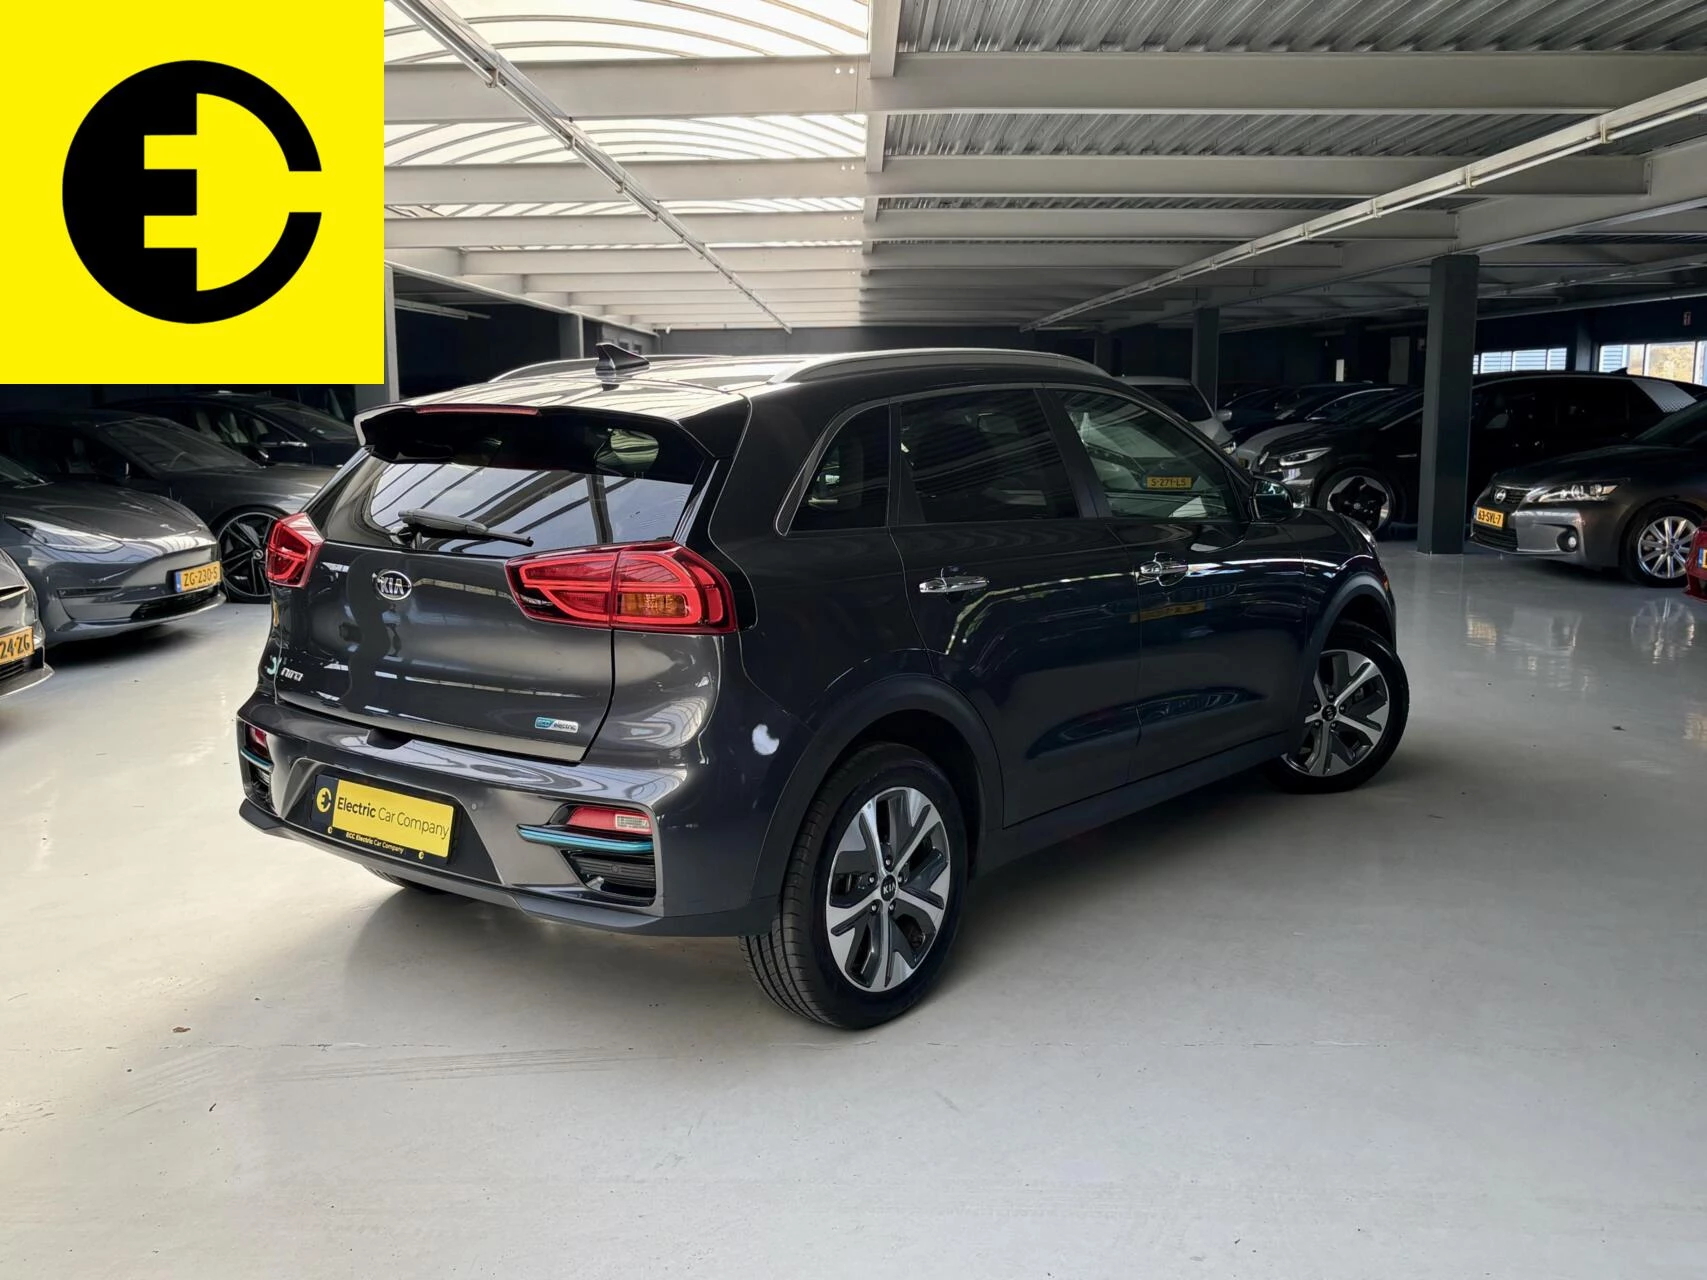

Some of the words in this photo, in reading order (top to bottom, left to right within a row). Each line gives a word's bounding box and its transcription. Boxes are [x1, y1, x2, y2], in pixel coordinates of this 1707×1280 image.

[380, 576, 405, 595] KIA
[337, 796, 376, 818] Electric
[378, 807, 396, 824] Car
[397, 811, 450, 840] Company
[374, 839, 382, 847] Car
[382, 842, 405, 855] Company
[883, 881, 896, 895] KIA
